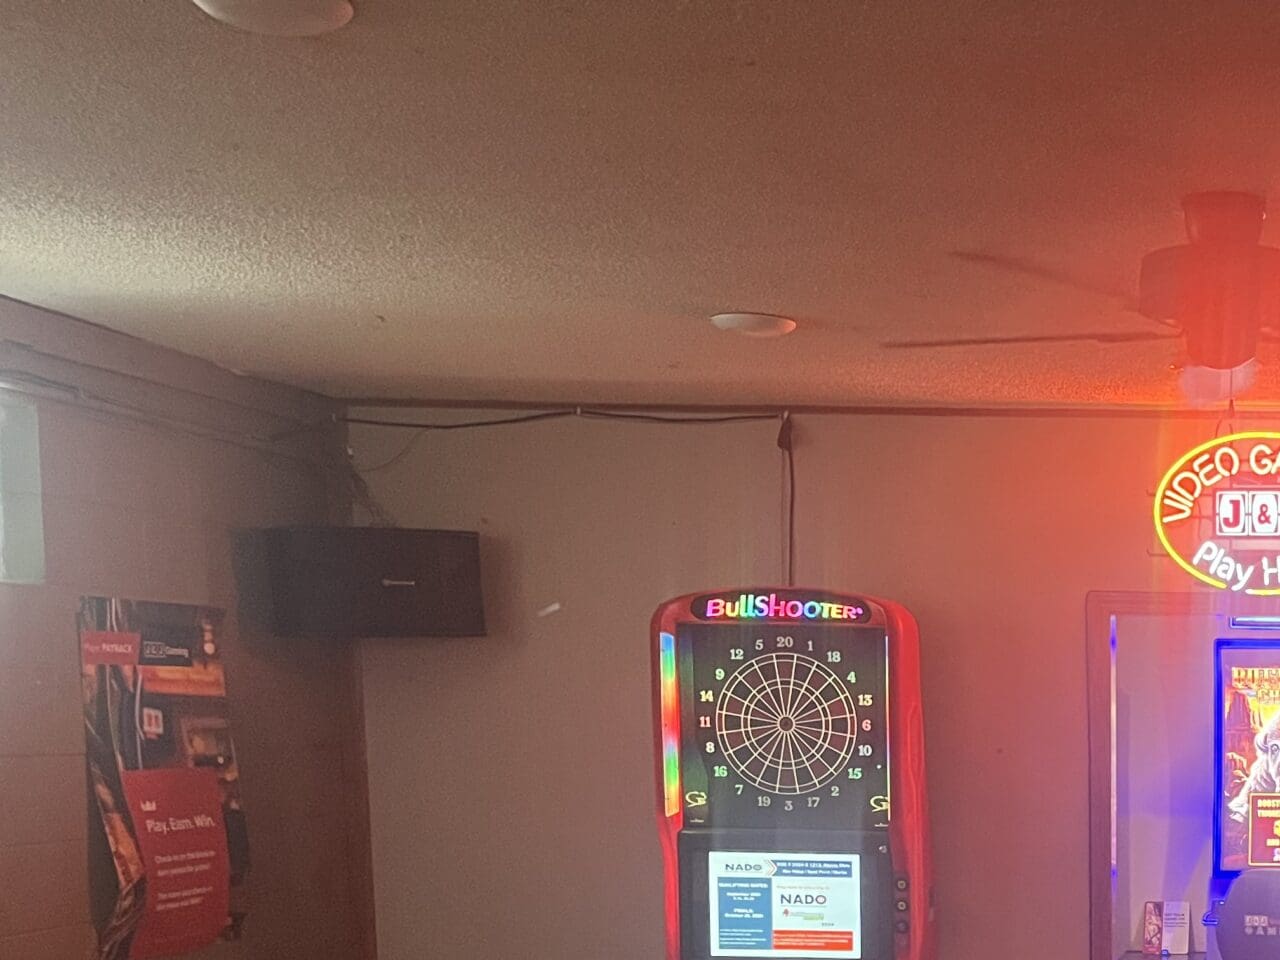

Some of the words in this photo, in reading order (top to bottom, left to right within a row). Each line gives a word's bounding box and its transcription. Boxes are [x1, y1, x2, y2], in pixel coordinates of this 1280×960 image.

[1162, 447, 1240, 523] VIDEO
[1192, 541, 1255, 591] Play
[755, 639, 763, 650] 5
[777, 637, 793, 647] 20
[808, 641, 813, 651] 1
[730, 649, 743, 659] 12
[827, 651, 840, 662] 18
[716, 669, 724, 680] 9
[847, 672, 855, 683] 4
[700, 690, 713, 702] 14
[858, 694, 872, 706] 13
[700, 716, 710, 727] 11
[862, 719, 871, 731] 6
[706, 742, 714, 753] 8
[858, 745, 872, 756] 10
[714, 766, 727, 777] 16
[848, 768, 862, 779] 15
[735, 785, 743, 794] 7
[831, 786, 839, 796] 2
[758, 796, 770, 806] 19
[785, 801, 793, 811] 3
[808, 797, 820, 807] 17
[725, 863, 763, 872] NADO
[780, 894, 827, 905] NADO
